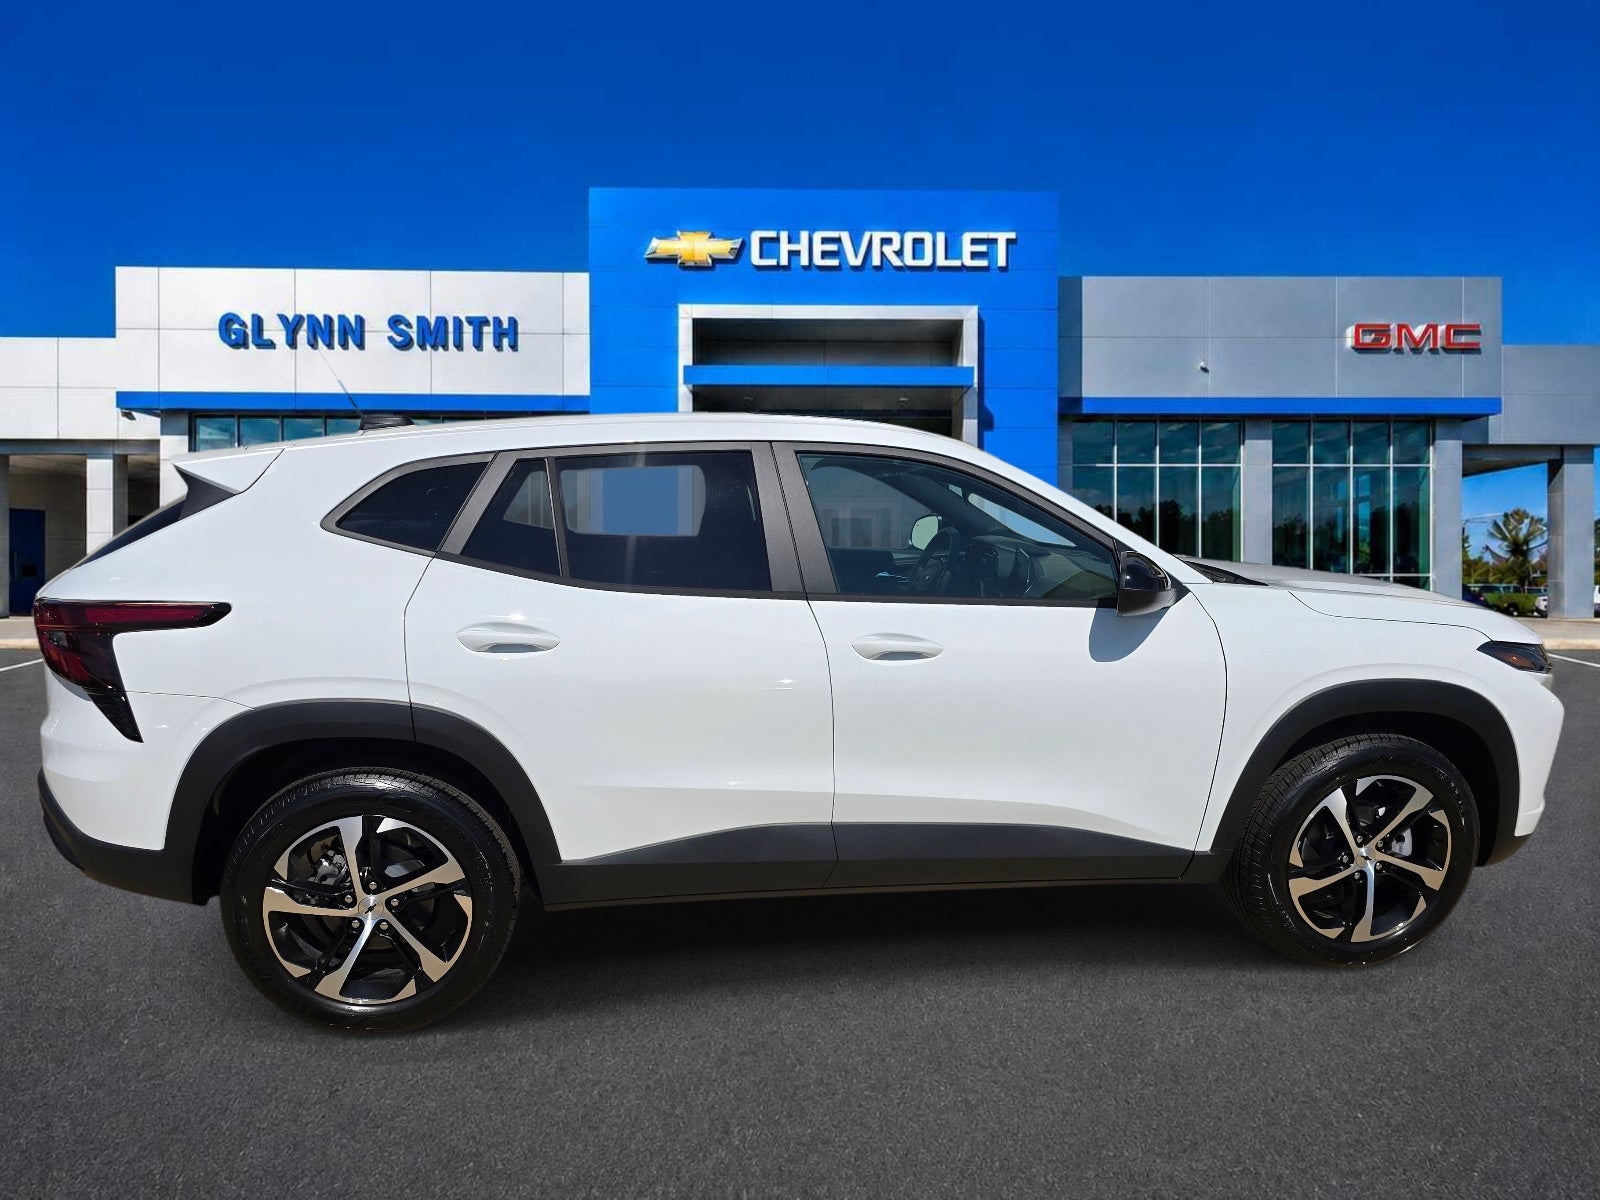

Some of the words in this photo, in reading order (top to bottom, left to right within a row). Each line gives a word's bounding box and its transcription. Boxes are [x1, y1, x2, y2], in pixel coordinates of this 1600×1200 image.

[750, 230, 1017, 269] CHEVROLET
[218, 312, 365, 350] GLYNN
[387, 313, 518, 352] SMITH
[1348, 322, 1482, 352] GMC
